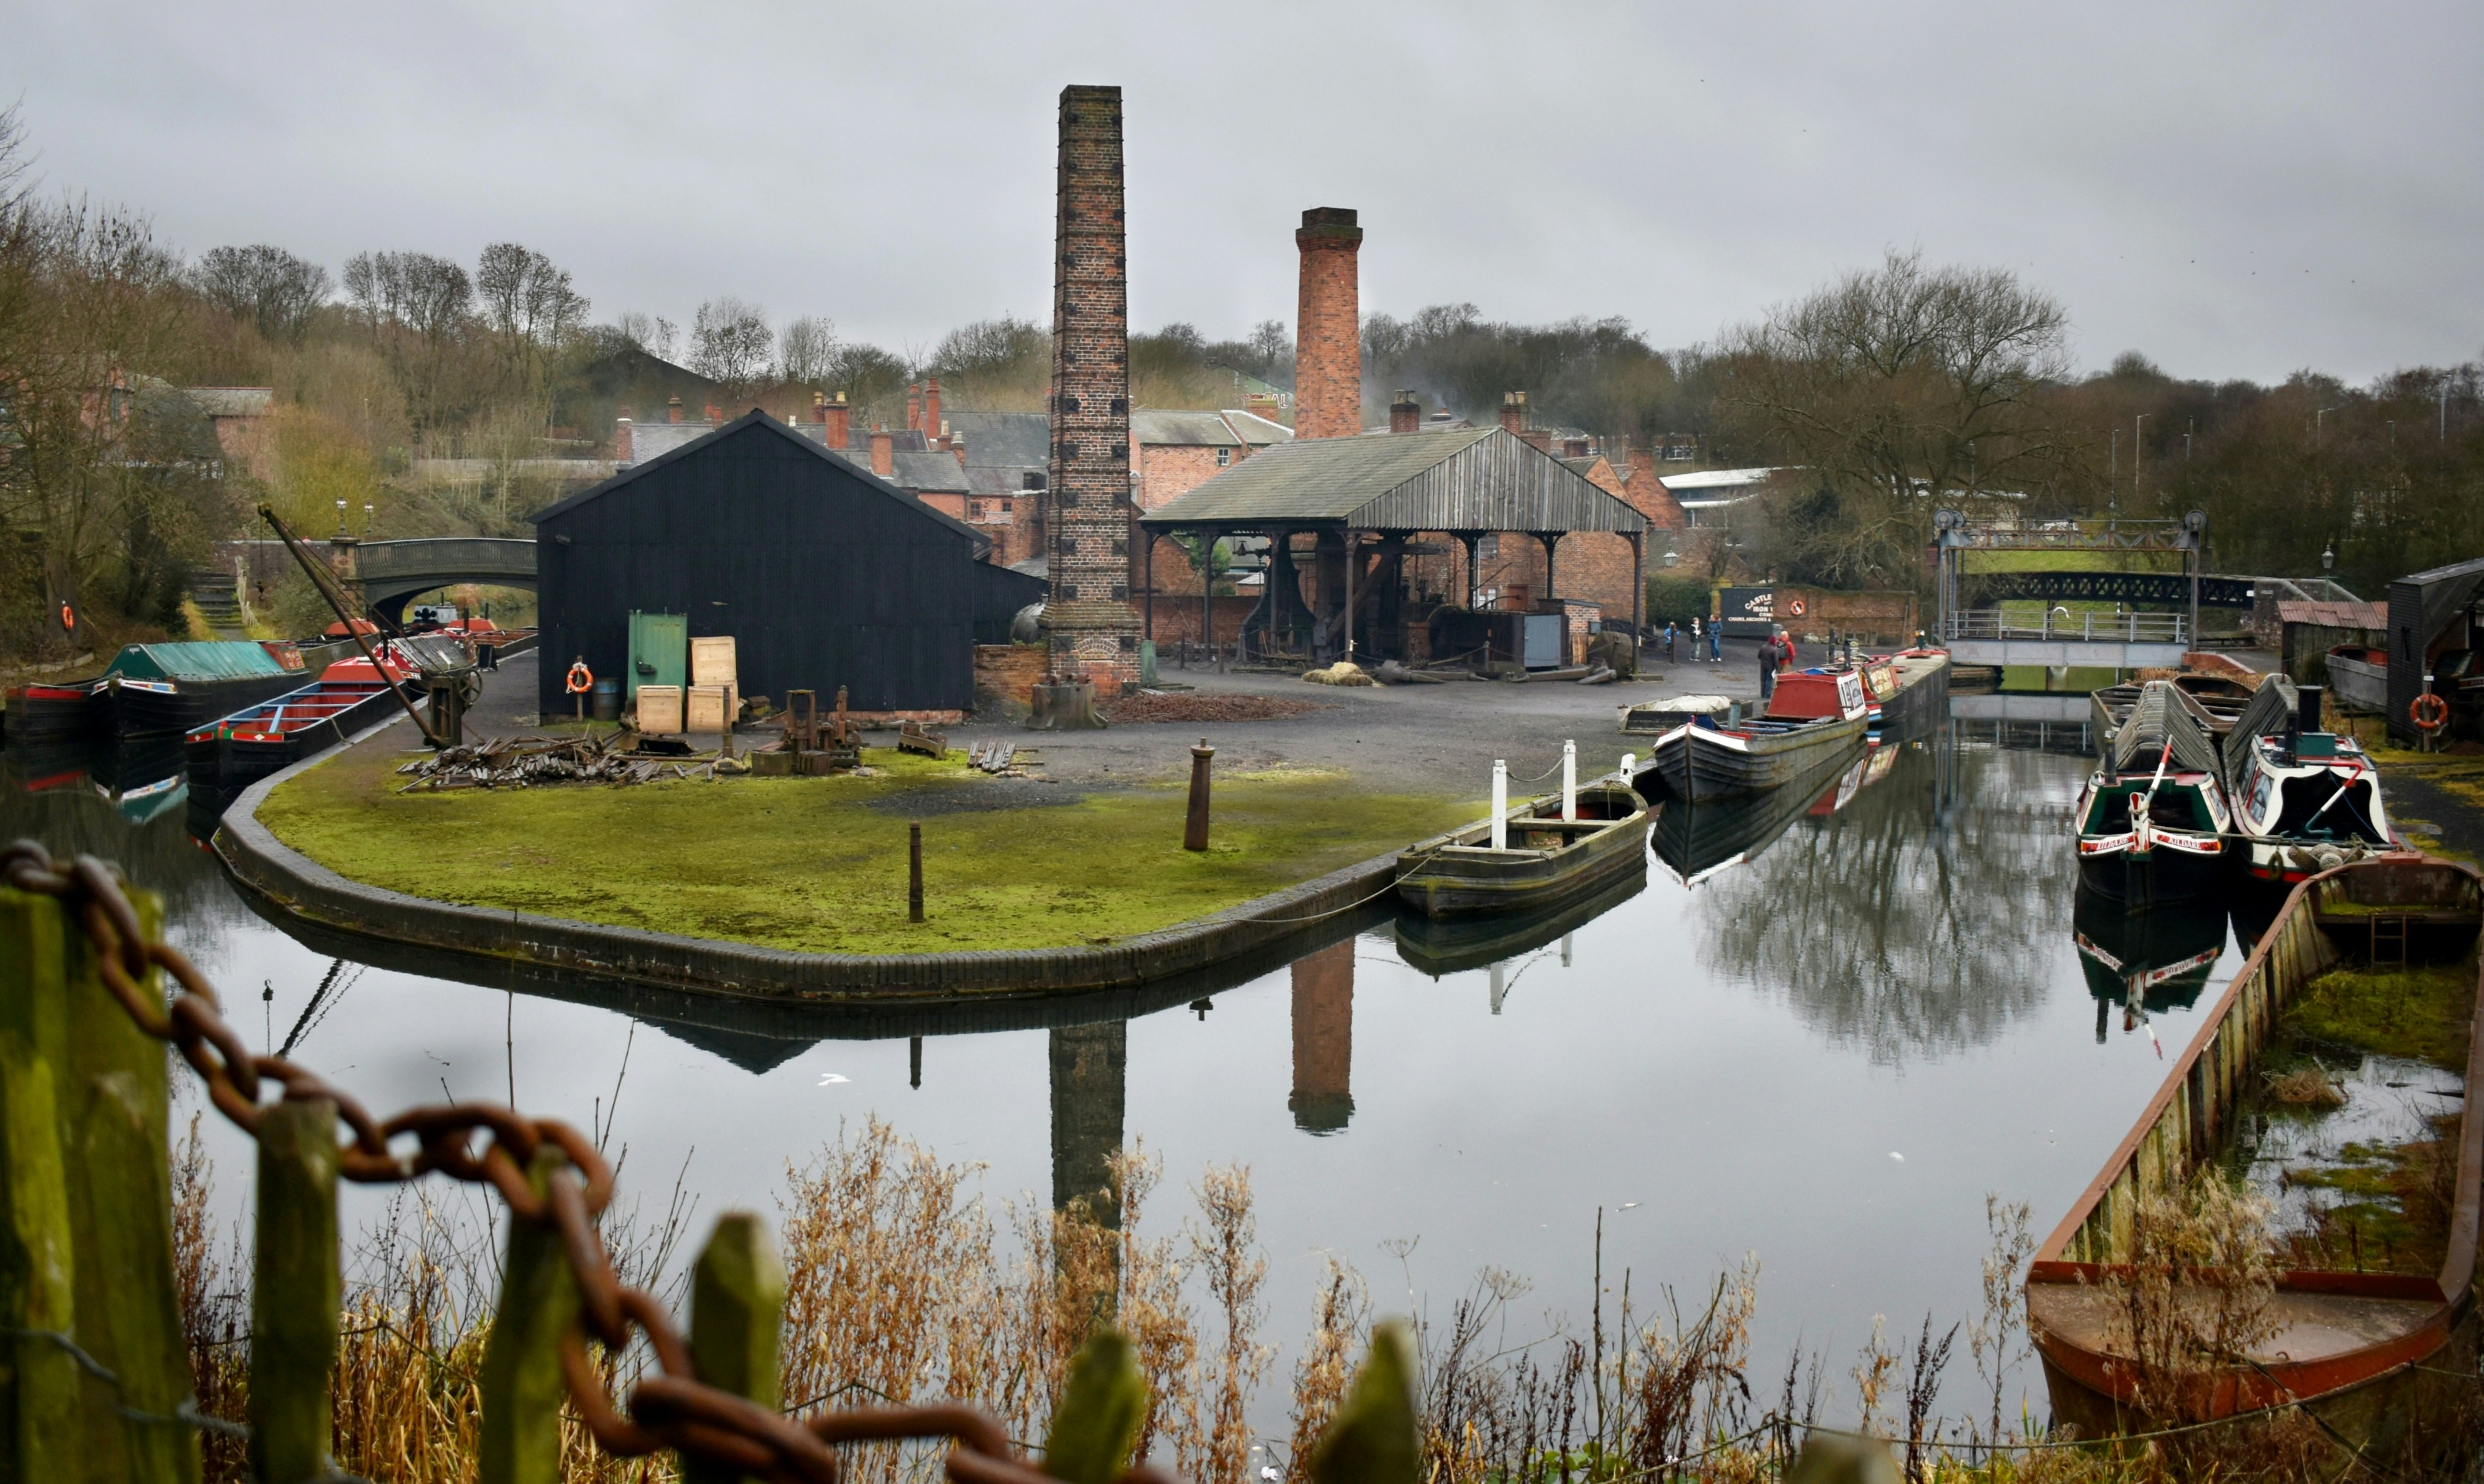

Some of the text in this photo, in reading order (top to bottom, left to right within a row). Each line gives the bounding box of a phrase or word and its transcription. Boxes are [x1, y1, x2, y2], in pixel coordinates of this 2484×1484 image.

[1745, 594, 1772, 609] CASTLE
[2097, 837, 2129, 850] KILDARE
[2169, 837, 2202, 849] KILDARE
